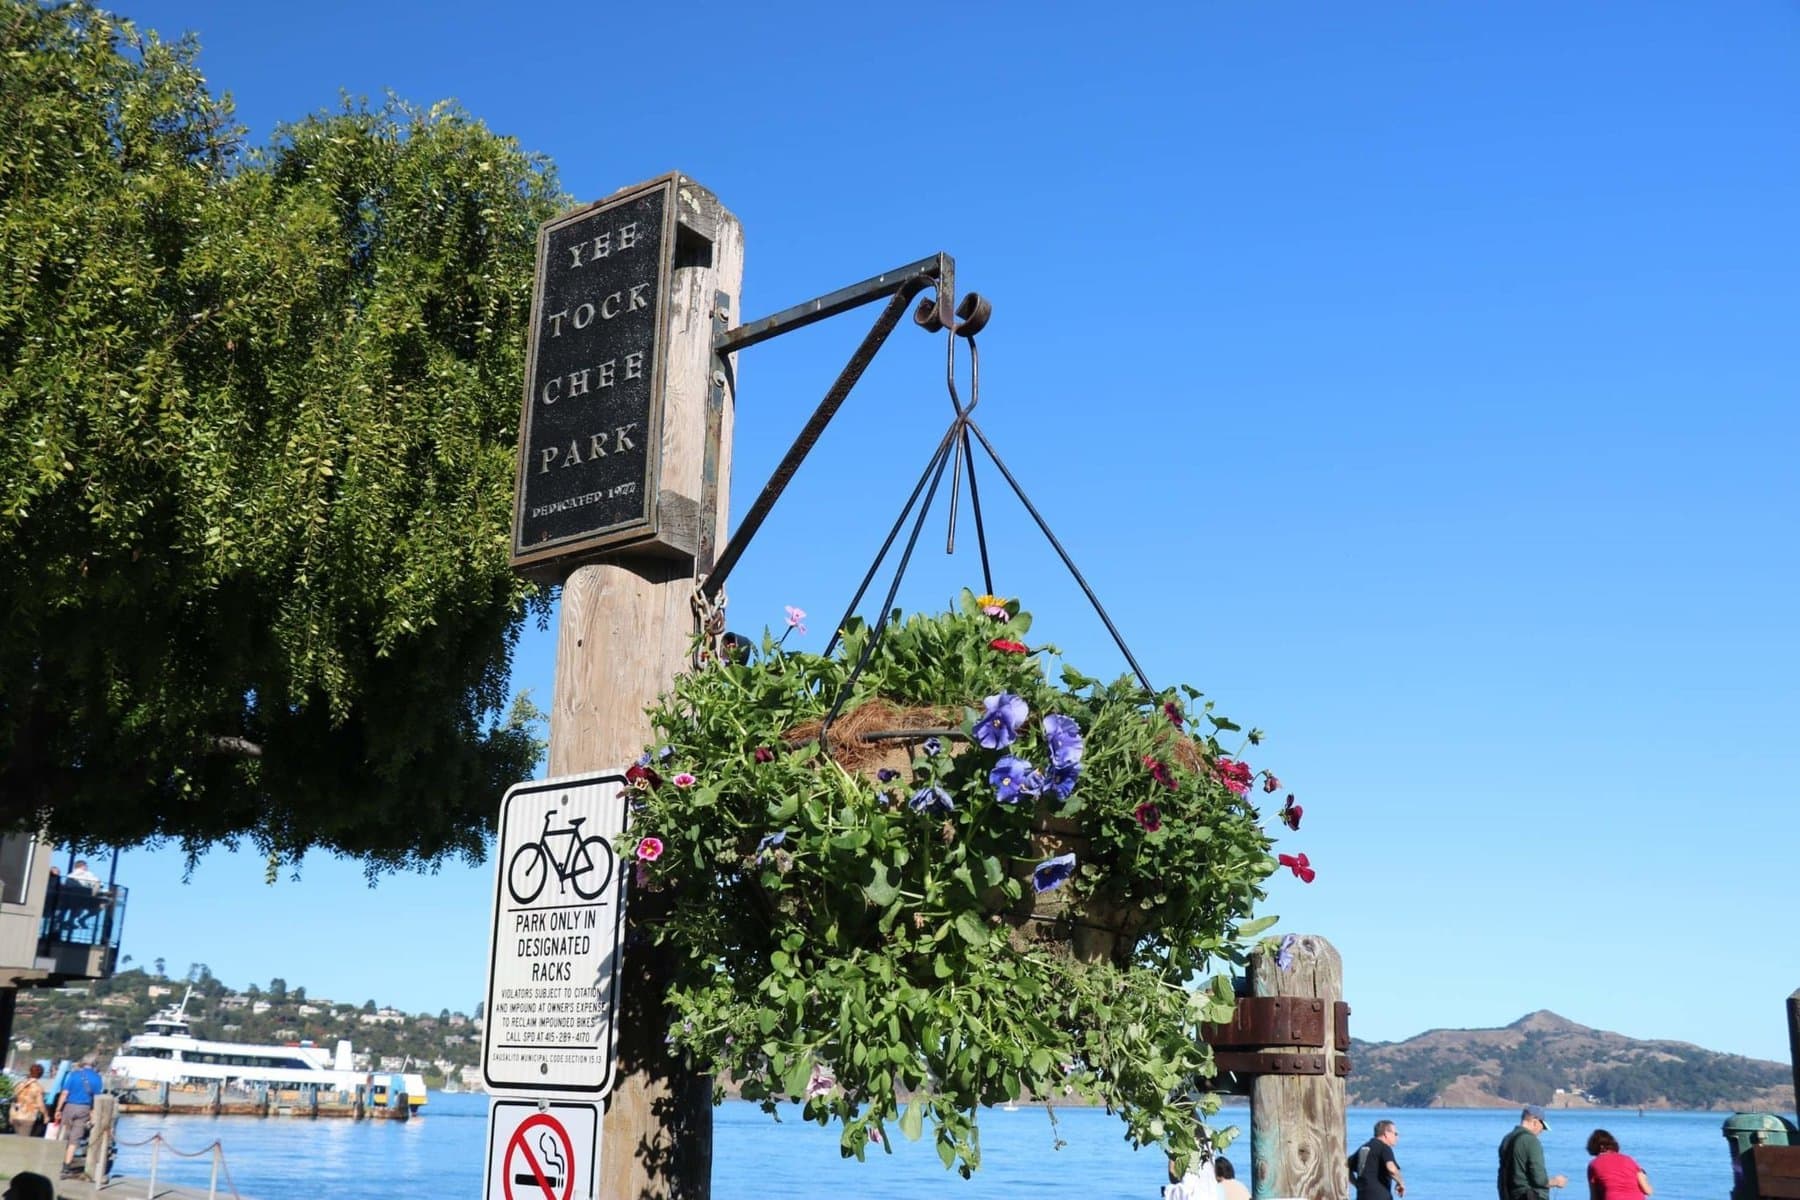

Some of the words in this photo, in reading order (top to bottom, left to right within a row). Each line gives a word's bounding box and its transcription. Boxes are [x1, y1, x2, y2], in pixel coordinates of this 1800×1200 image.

[569, 222, 640, 270] YEE
[548, 282, 650, 339] TOCK
[542, 350, 645, 406] CHEE
[538, 422, 637, 475] PARK
[532, 491, 602, 518] DEDICATED
[608, 481, 635, 498] 1977
[515, 913, 546, 933] PARK
[550, 911, 582, 931] ONLY
[584, 910, 597, 929] IN
[517, 936, 590, 957] DESIGNATED
[531, 962, 571, 981] RACKS
[501, 988, 533, 998] VIOLATORS
[535, 988, 561, 998] SUBJECT
[564, 987, 571, 998] TO
[574, 987, 601, 998] CITATION
[496, 1003, 507, 1012] AND
[509, 1003, 536, 1013] IMPOUND
[538, 1003, 545, 1013] AT
[576, 1002, 606, 1013] EXPENSE
[503, 1017, 510, 1027] TO
[511, 1017, 537, 1027] RECLAIM
[540, 1017, 574, 1027] IMPOUNDED
[576, 1017, 595, 1028] BIKES
[506, 1032, 520, 1042] CALL
[523, 1032, 535, 1042] SPD
[536, 1032, 543, 1041] AT
